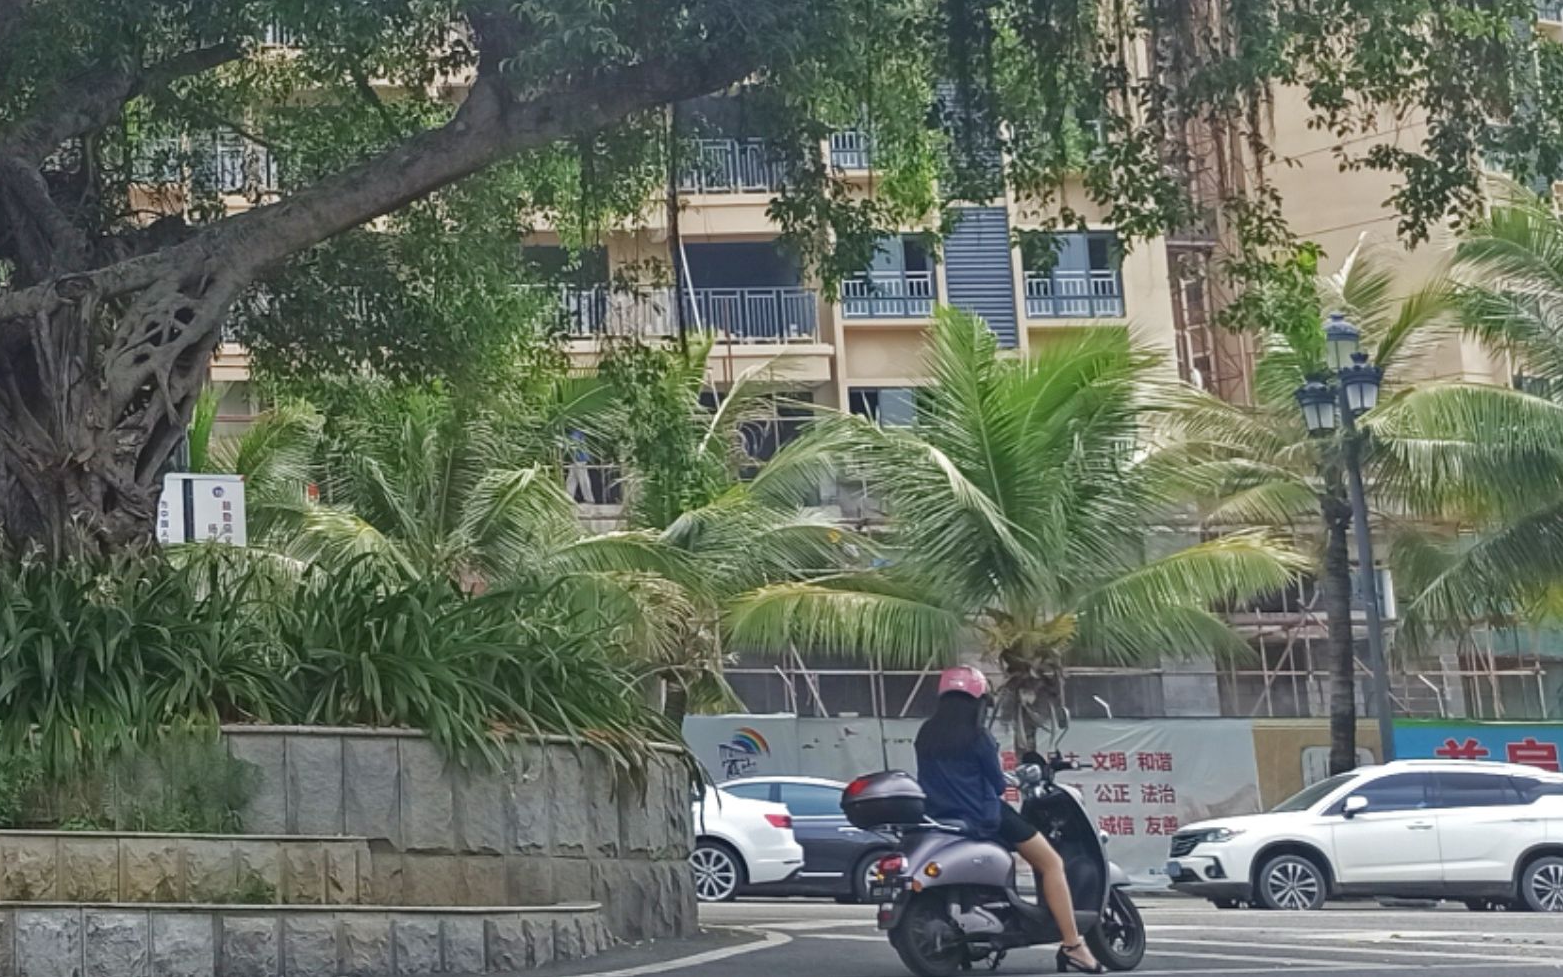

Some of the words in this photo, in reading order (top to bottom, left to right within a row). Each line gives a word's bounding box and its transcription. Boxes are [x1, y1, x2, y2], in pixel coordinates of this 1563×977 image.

[1091, 751, 1127, 772] 文明
[1138, 752, 1173, 772] 和谐
[1095, 784, 1131, 803] 公正
[1141, 784, 1176, 803] 法治
[1098, 816, 1135, 836] 诚信
[1145, 816, 1178, 836] 友善
